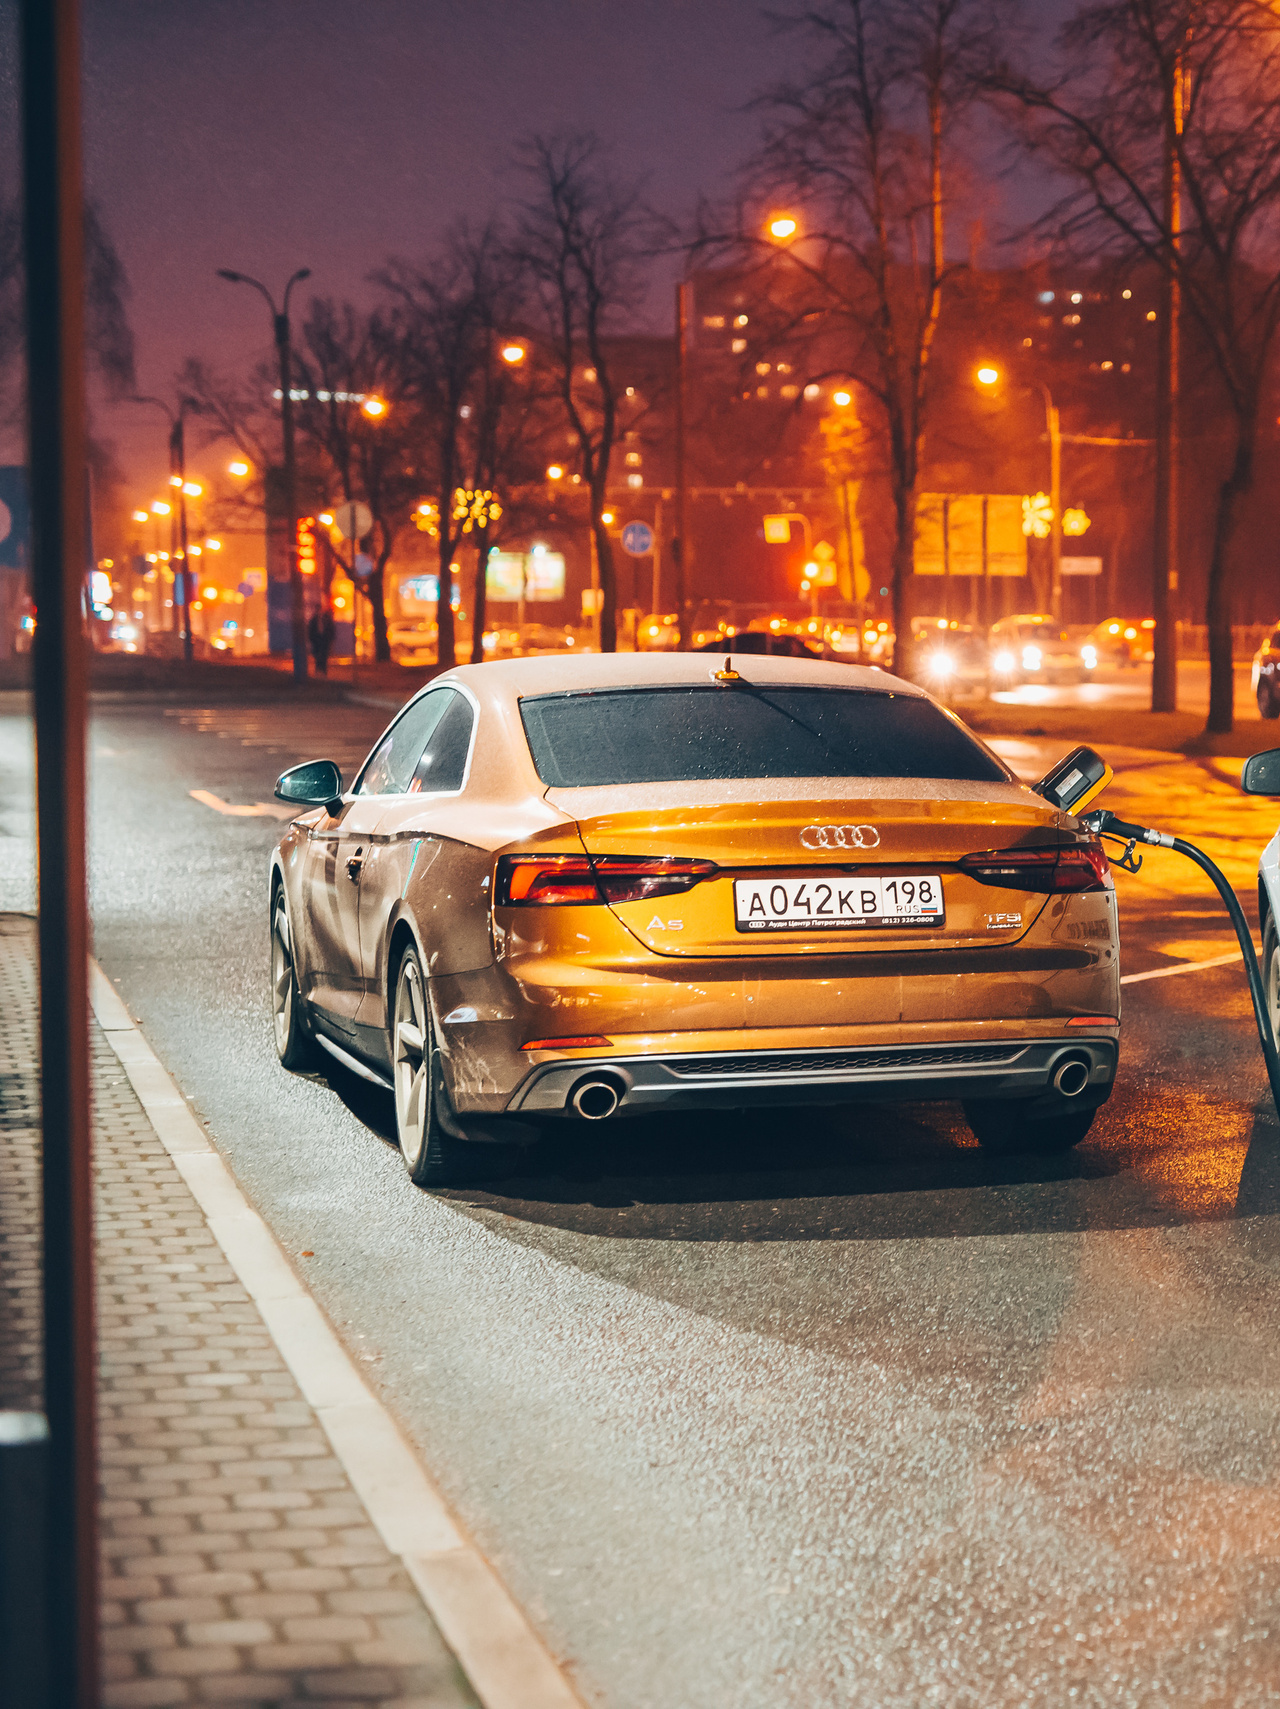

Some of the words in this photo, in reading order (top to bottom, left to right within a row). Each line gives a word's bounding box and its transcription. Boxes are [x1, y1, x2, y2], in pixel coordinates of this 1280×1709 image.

[885, 880, 933, 905] 198
[896, 904, 920, 914] RUS
[984, 912, 1022, 923] TFSI
